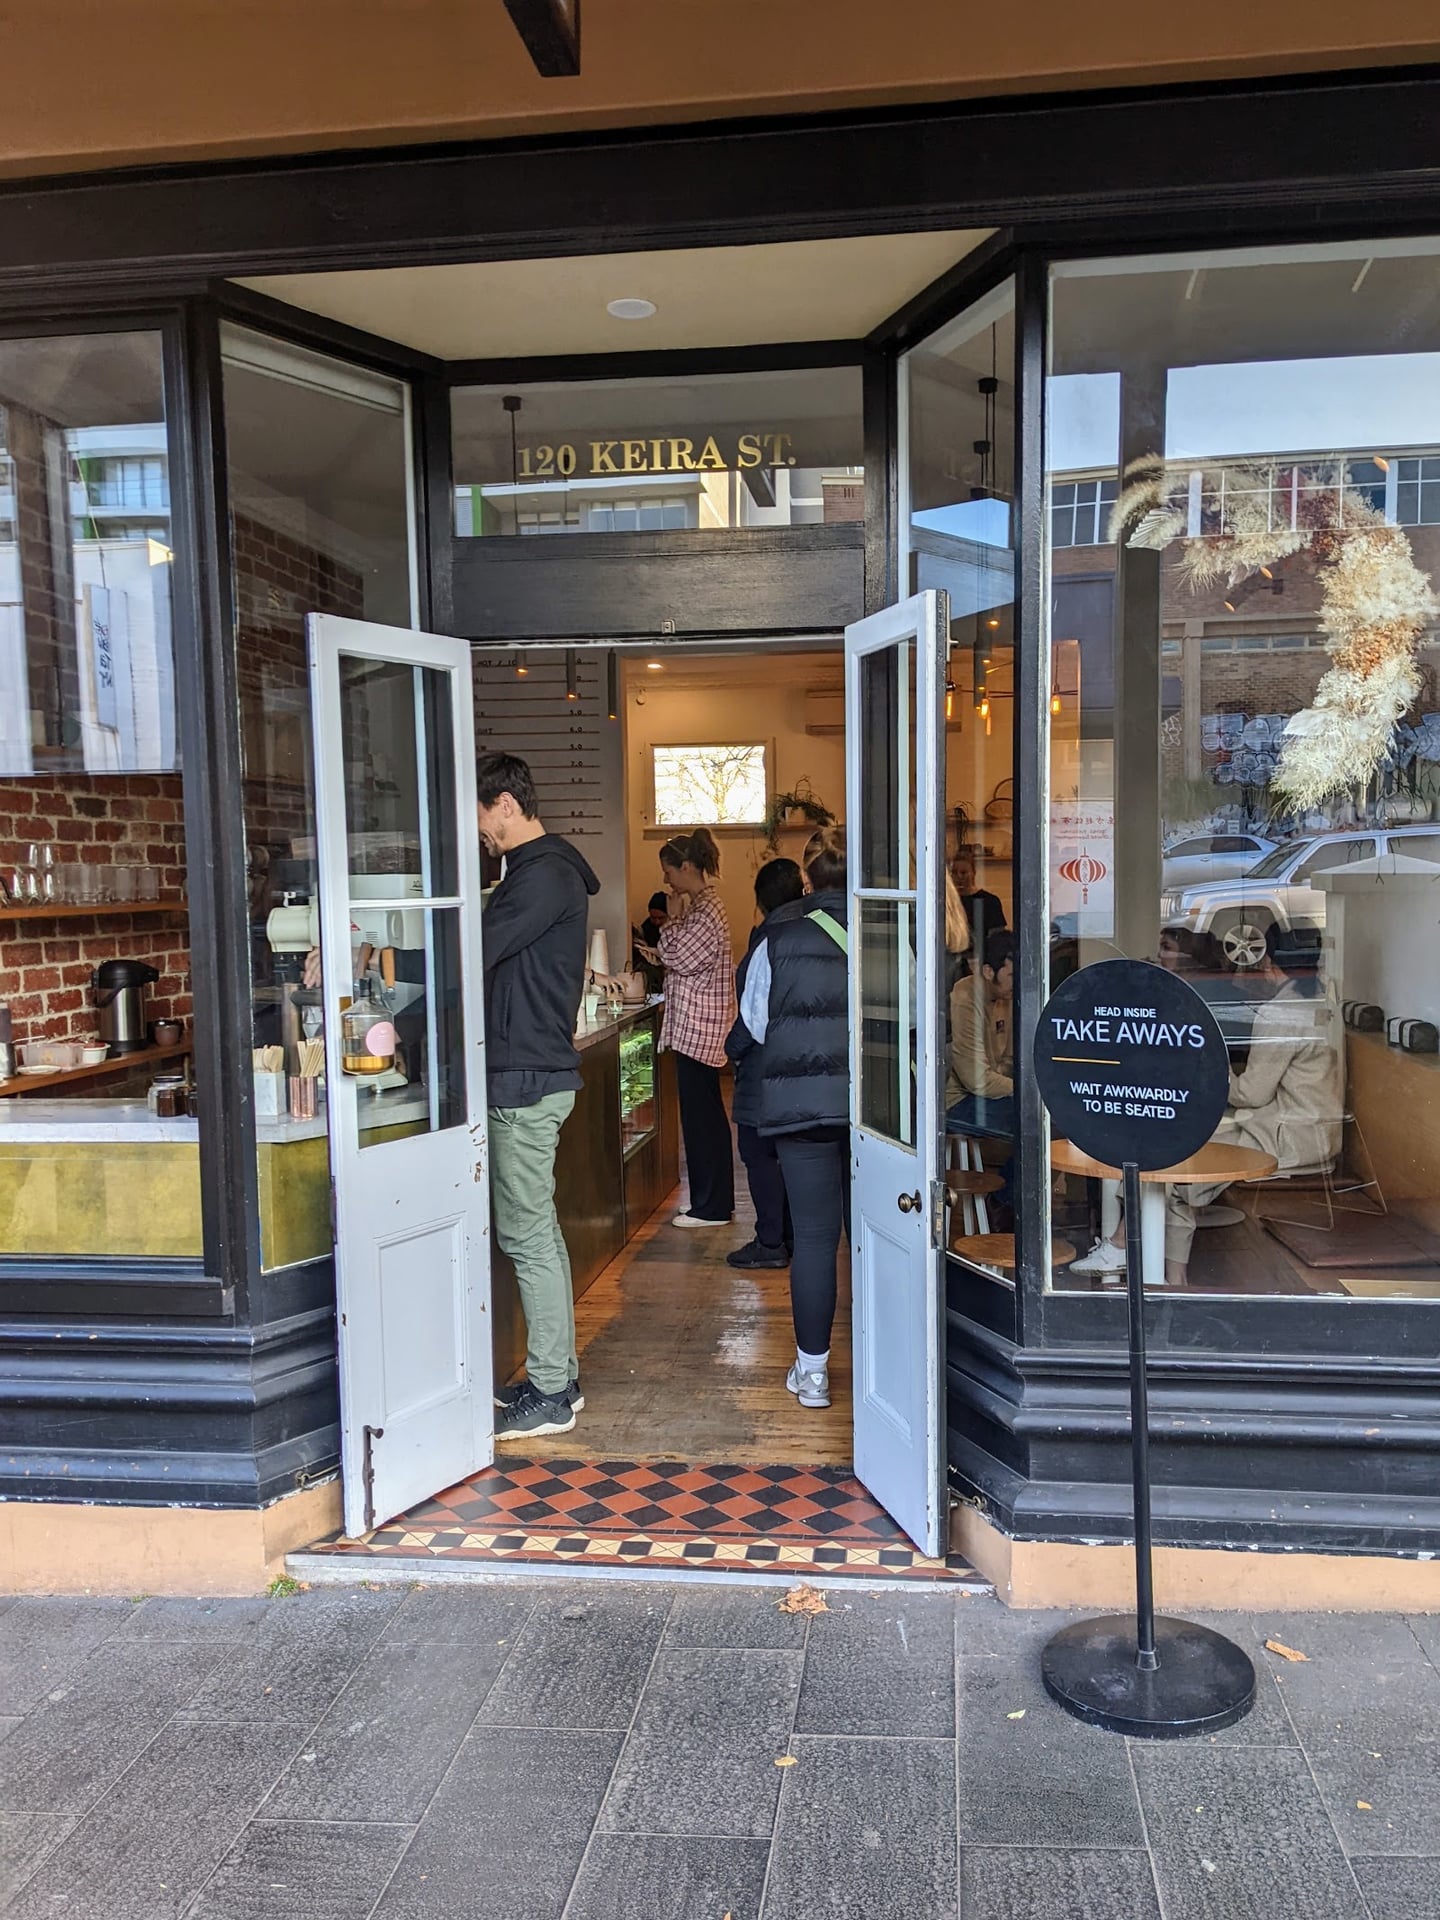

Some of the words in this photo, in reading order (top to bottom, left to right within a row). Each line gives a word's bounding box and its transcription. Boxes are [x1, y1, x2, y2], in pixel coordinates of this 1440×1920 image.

[518, 445, 577, 477] 120
[589, 436, 727, 473] KEIRA
[737, 434, 797, 468] ST.
[1094, 1006, 1121, 1017] HEAD
[1123, 1007, 1157, 1018] INSIDE
[1051, 1018, 1110, 1043] TAKE
[1116, 1021, 1205, 1048] AWAYS
[1070, 1081, 1102, 1096] WAIT
[1103, 1084, 1190, 1103] AWKWARDLY
[1083, 1099, 1101, 1113] TO
[1104, 1102, 1122, 1115] BE
[1125, 1103, 1176, 1119] SEATED
